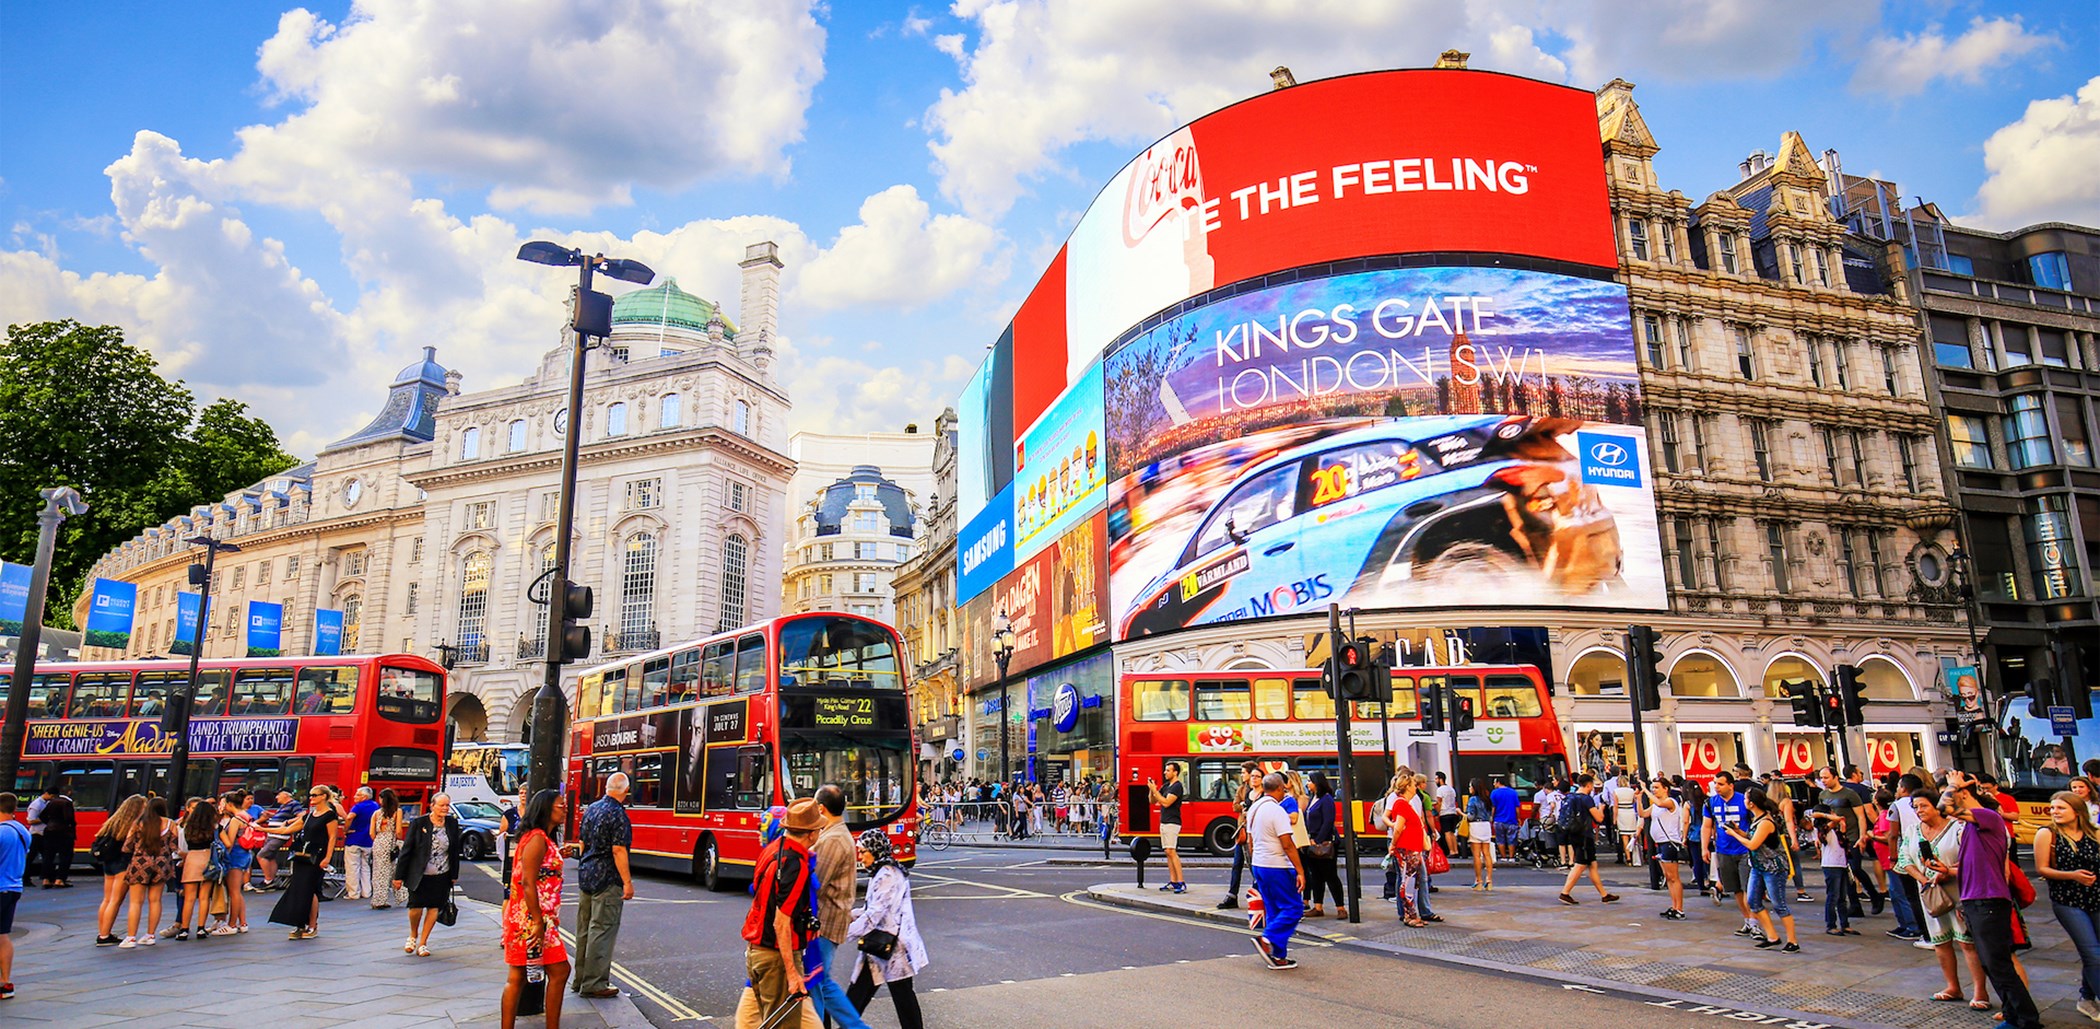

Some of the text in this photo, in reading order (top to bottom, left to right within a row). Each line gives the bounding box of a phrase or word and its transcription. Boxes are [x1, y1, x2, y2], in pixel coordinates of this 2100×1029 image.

[1230, 170, 1320, 221] THE
[1215, 296, 1498, 367] KINGS GATE
[1218, 345, 1548, 414] LONDON SW1
[714, 456, 736, 470] ALLIANCE
[752, 471, 766, 482] OFFICE
[1587, 466, 1635, 480] HYUNDAI
[1310, 464, 1346, 506] 20
[963, 518, 1006, 577] SAMSUNG
[1009, 561, 1041, 616] DAGEN
[1181, 573, 1199, 600] 20
[1249, 572, 1334, 618] MOBIS
[857, 698, 872, 713] 22
[1053, 691, 1074, 724] Boots
[221, 720, 293, 735] TRIUMPHANTLY
[713, 719, 739, 732] JULY 27
[815, 714, 873, 727] Piccadilly Circus
[1260, 729, 1296, 737] Fresher.
[1298, 729, 1337, 738] Sweeter.
[106, 730, 121, 738] Disney
[189, 736, 201, 752] IN
[204, 735, 228, 751] THE
[231, 734, 262, 751] WEST
[1260, 738, 1282, 747] With
[1283, 738, 1321, 748] Hotpoint
[1682, 738, 1721, 771] 70
[1777, 738, 1812, 770] 70
[449, 777, 477, 788] MAJESTIC
